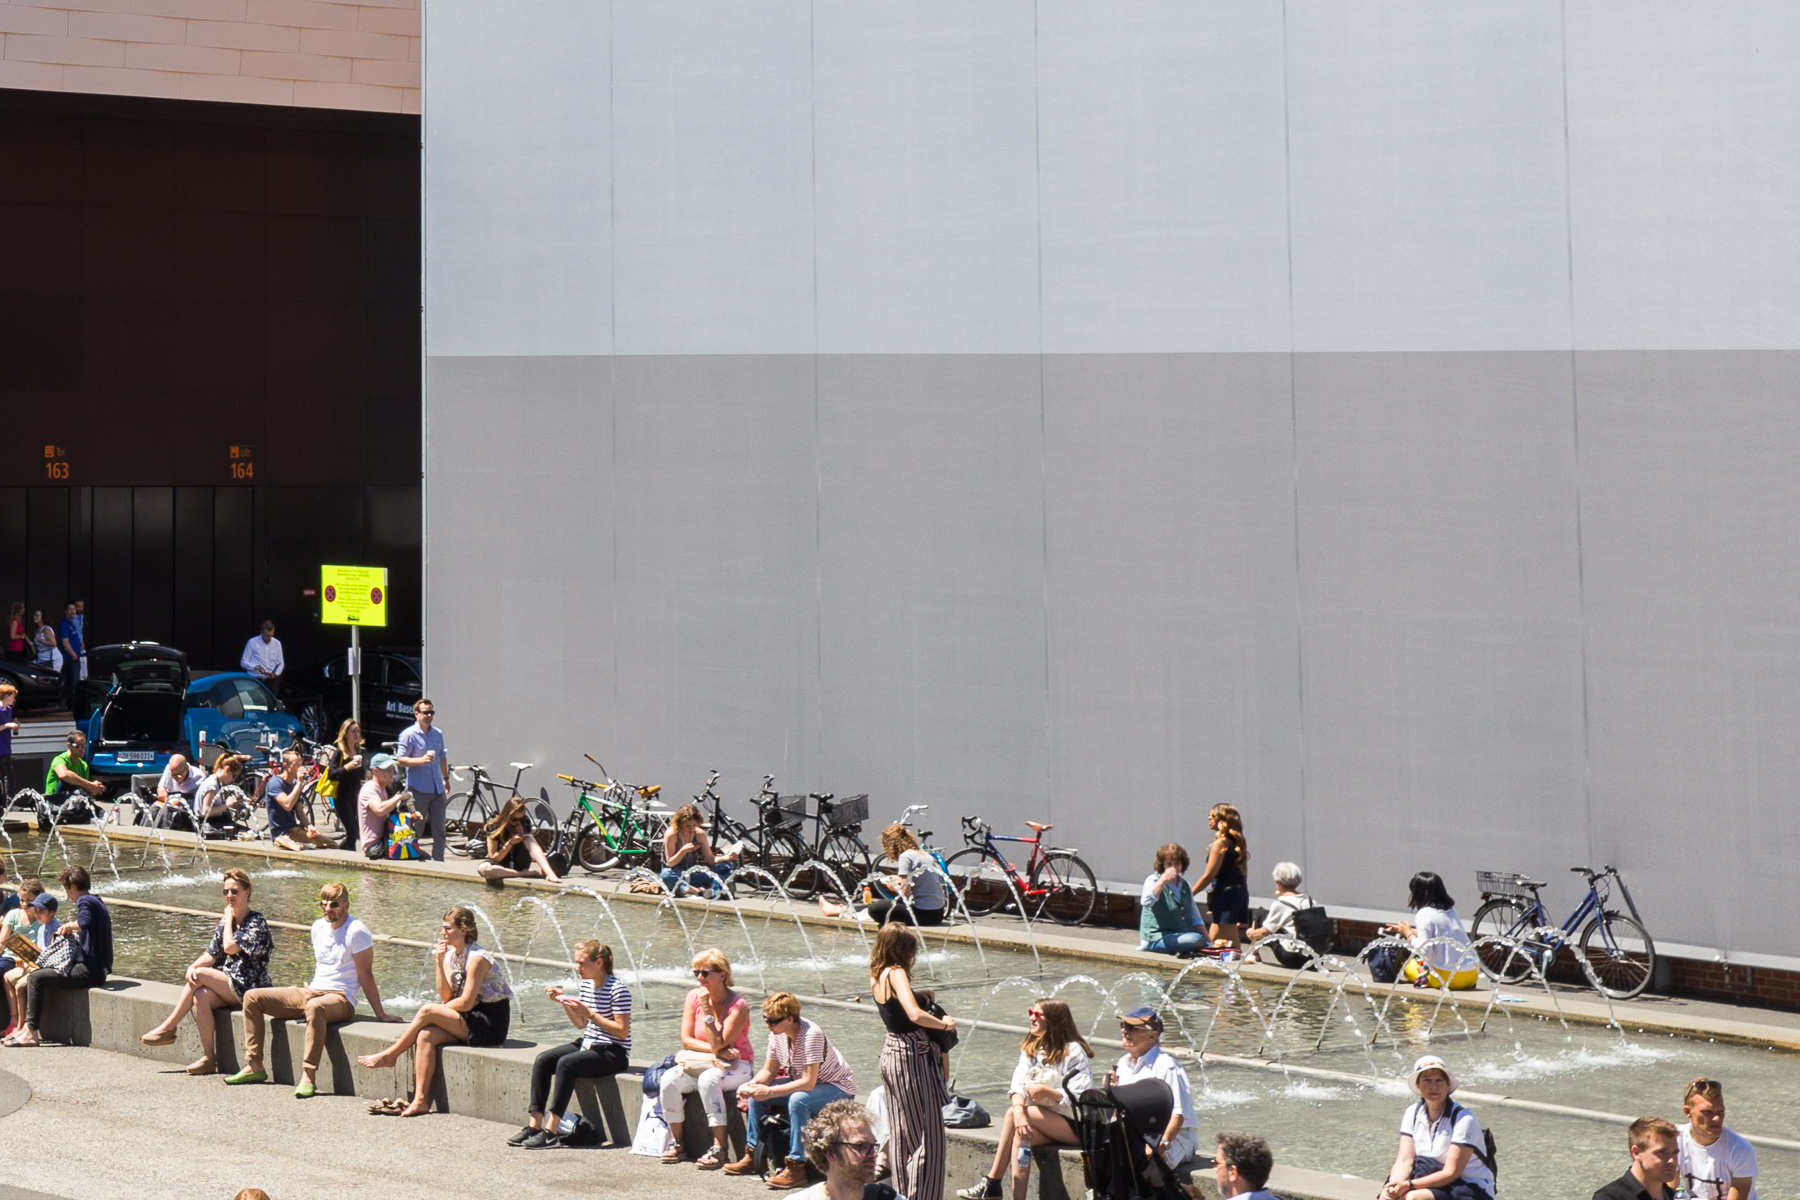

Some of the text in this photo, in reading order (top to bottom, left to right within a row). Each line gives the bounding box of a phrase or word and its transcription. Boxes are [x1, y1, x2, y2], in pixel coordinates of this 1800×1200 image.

[46, 462, 69, 479] 163
[231, 462, 254, 479] 164
[386, 700, 396, 712] Art
